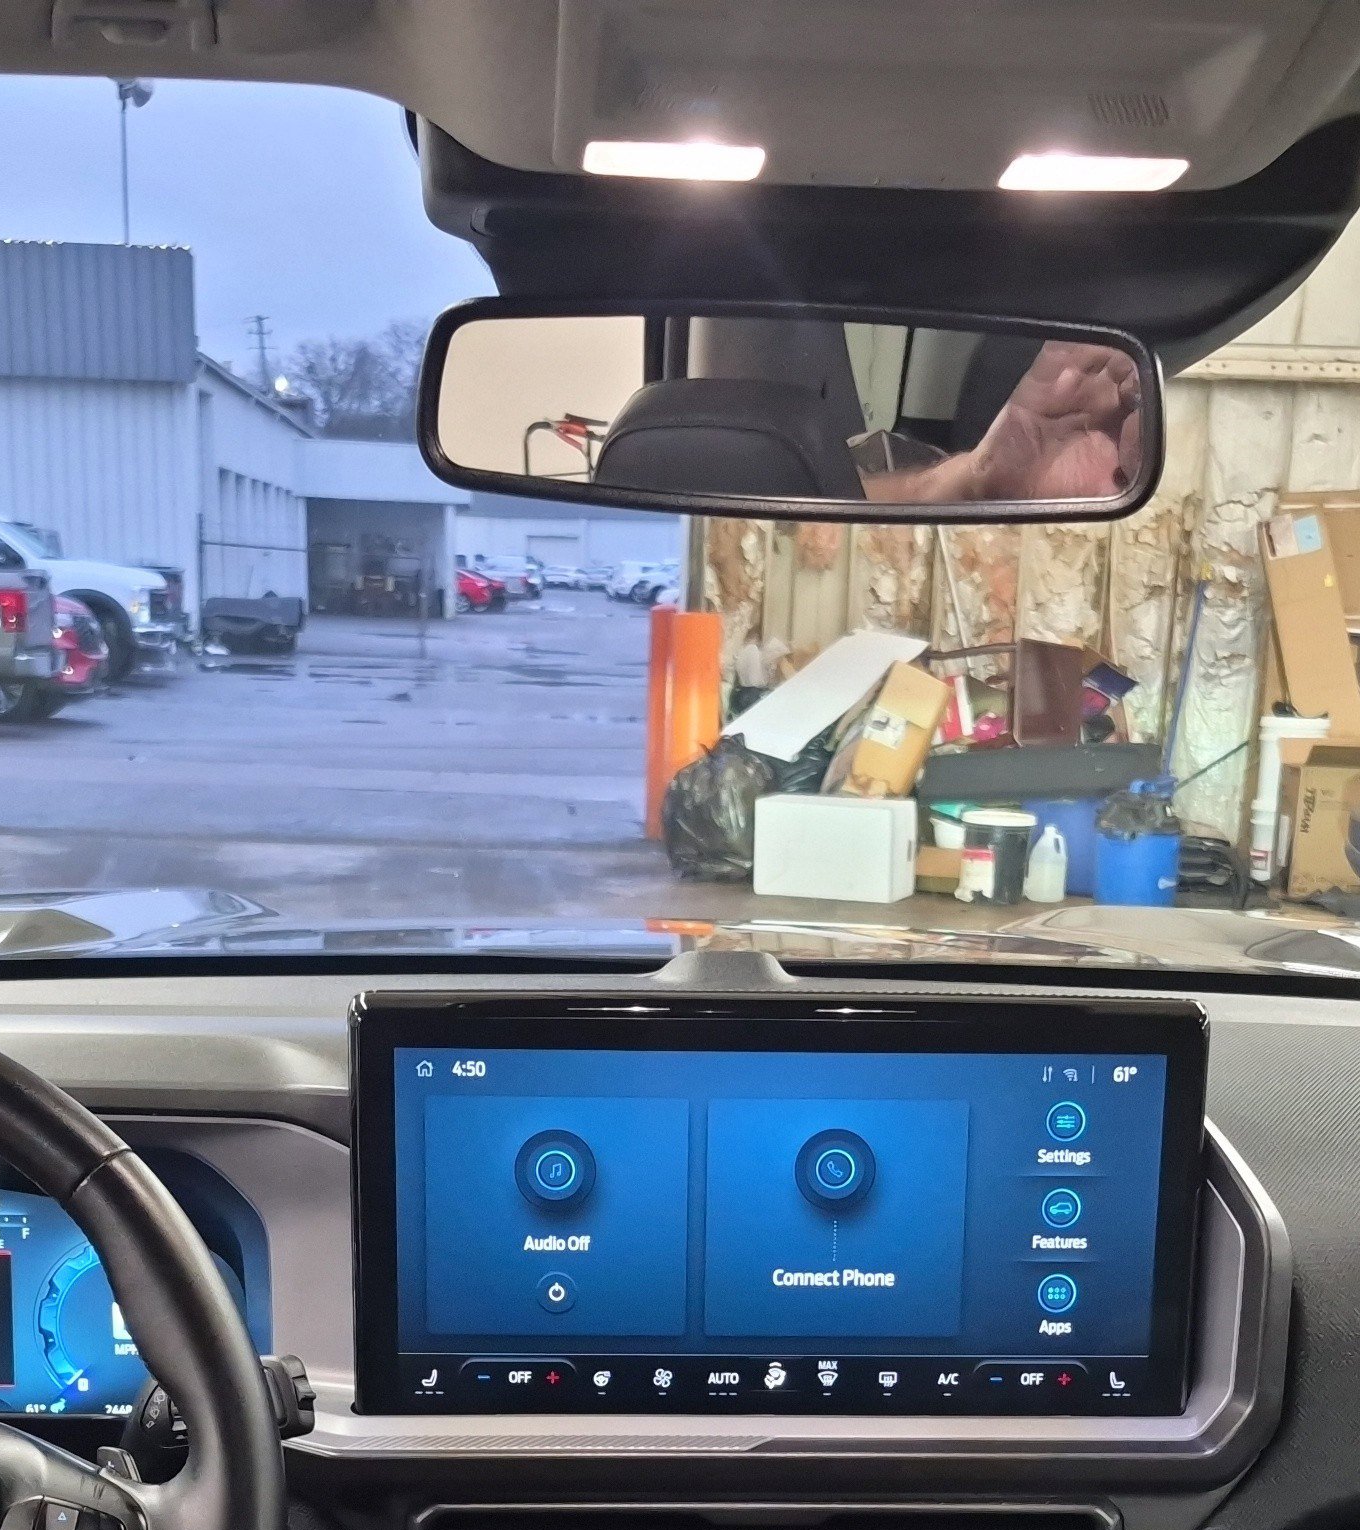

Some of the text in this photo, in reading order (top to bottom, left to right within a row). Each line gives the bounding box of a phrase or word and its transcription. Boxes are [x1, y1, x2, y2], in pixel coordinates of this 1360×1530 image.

[452, 1061, 486, 1077] 4:50
[1113, 1066, 1138, 1083] 61°
[1038, 1149, 1091, 1166] Settings
[22, 1228, 30, 1239] F
[523, 1235, 590, 1251] Audio Off
[1032, 1235, 1087, 1250] Features
[772, 1269, 895, 1287] Connect Phone
[1039, 1320, 1072, 1336] Apps
[818, 1361, 838, 1370] MAX
[508, 1371, 532, 1384] OFF
[708, 1372, 739, 1385] AUTO
[937, 1373, 959, 1386] A/C
[1020, 1372, 1044, 1386] OFF
